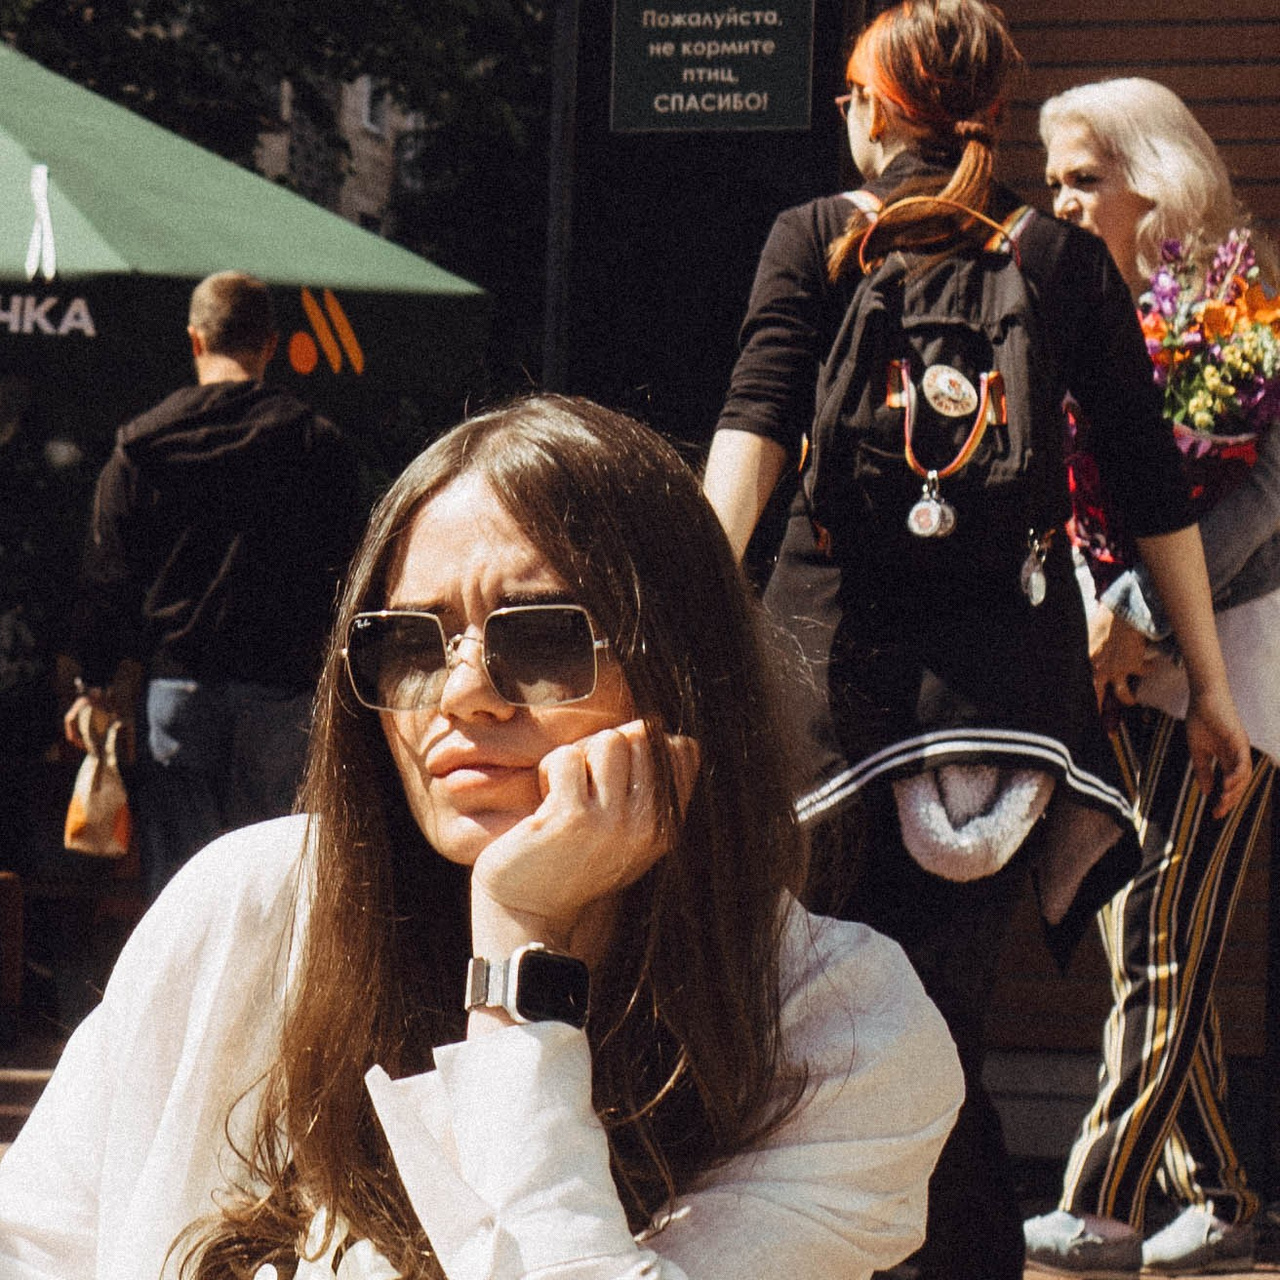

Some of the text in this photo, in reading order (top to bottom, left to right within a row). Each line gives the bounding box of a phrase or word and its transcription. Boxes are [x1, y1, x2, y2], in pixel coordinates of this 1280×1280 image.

[649, 39, 777, 60] не кормите
[653, 92, 769, 113] СПАСИБО!
